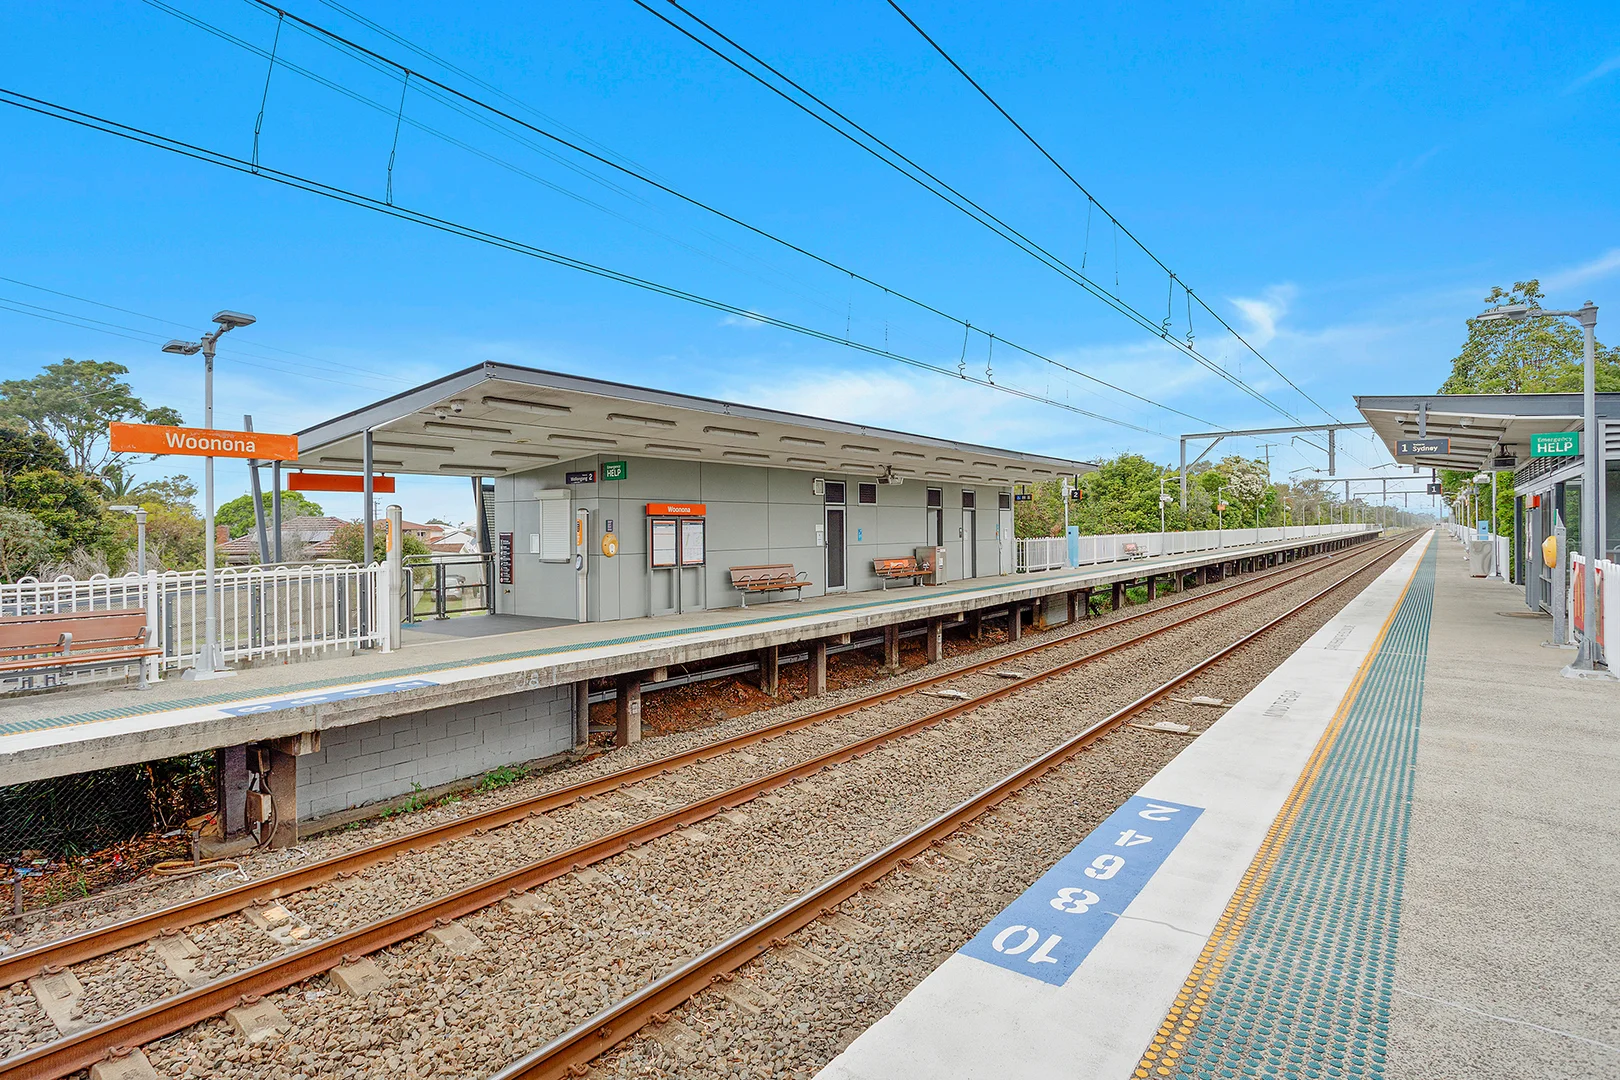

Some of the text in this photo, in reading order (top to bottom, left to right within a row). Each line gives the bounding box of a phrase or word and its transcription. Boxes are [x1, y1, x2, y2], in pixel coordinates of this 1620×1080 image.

[165, 432, 256, 453] Woonona
[1401, 443, 1438, 453] 1 Sydney
[1537, 441, 1573, 453] HELP
[588, 473, 593, 481] 2
[606, 469, 622, 478] HELP
[1431, 485, 1437, 493] 1
[667, 505, 691, 513] Woonona
[1138, 803, 1181, 822] 2
[1114, 829, 1153, 848] 4
[1084, 854, 1126, 880] 6
[1049, 887, 1101, 914] 8
[991, 924, 1063, 965] 10
